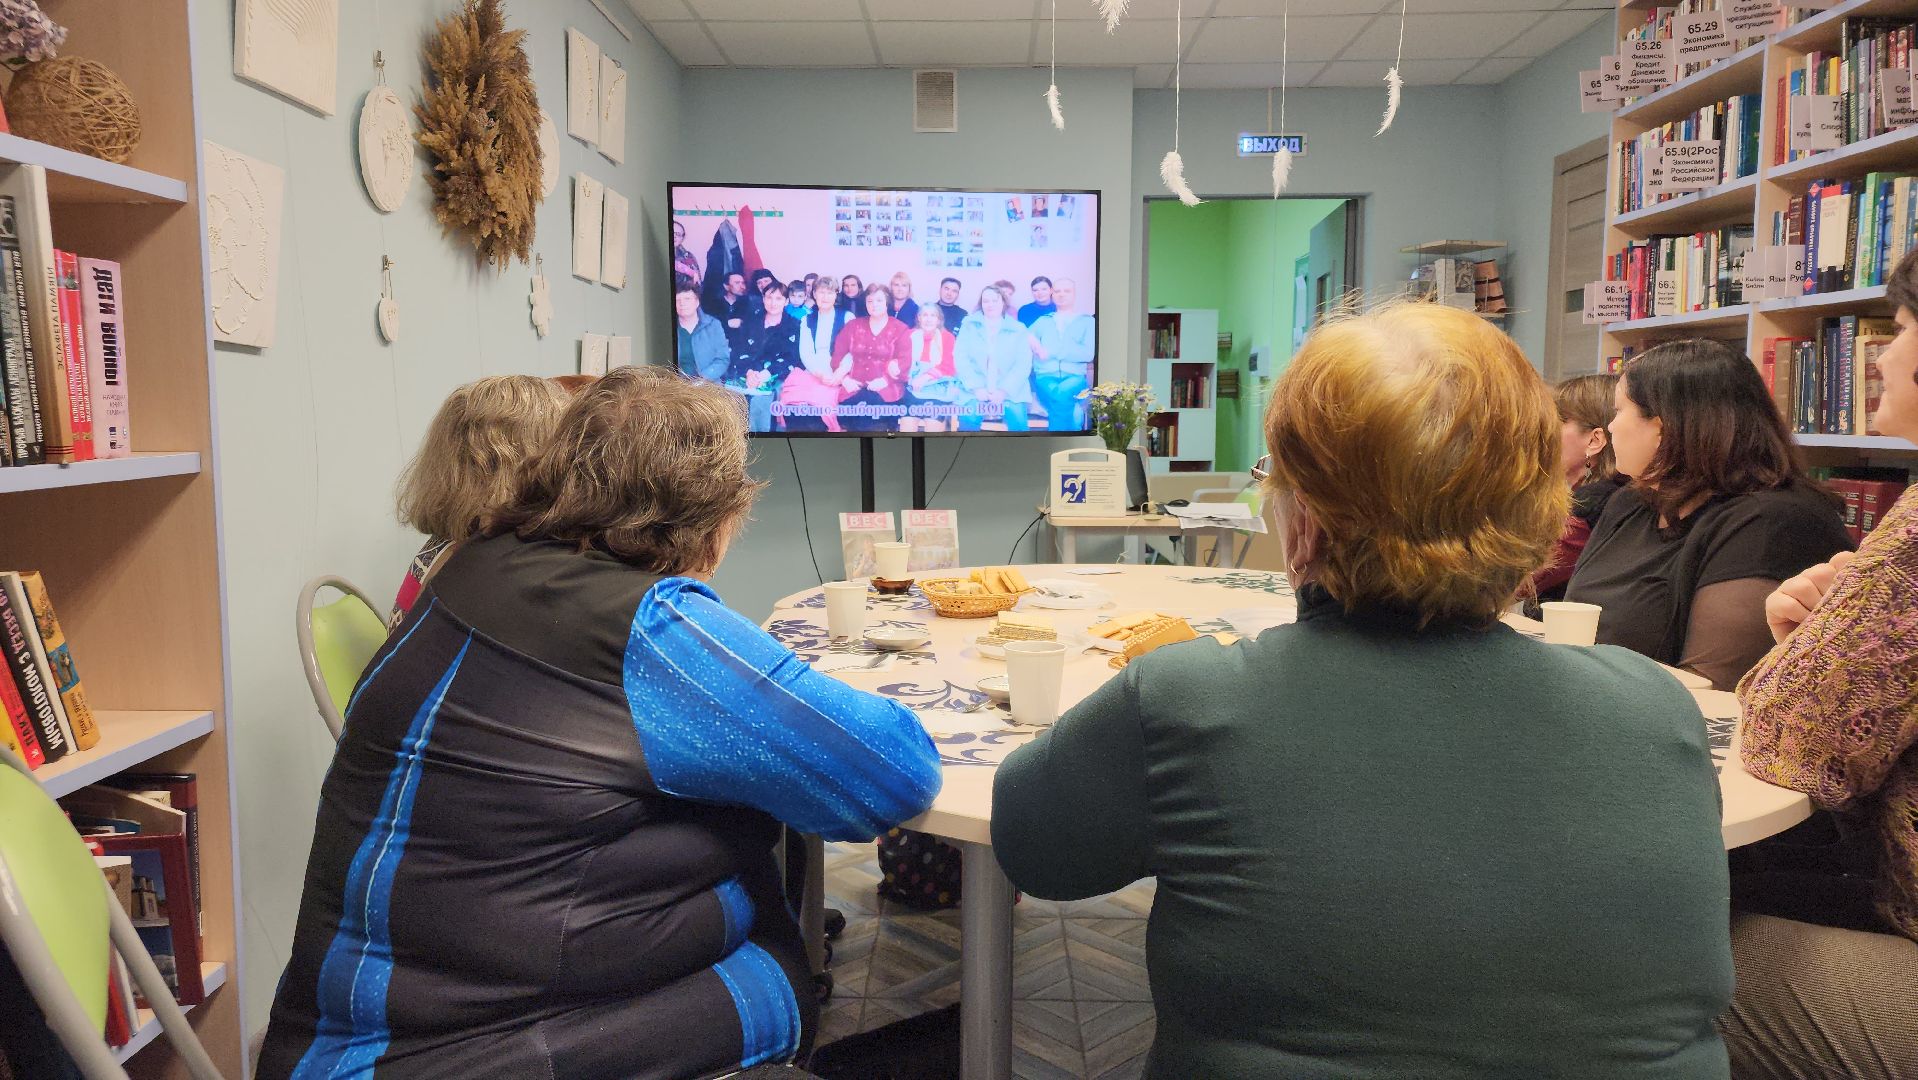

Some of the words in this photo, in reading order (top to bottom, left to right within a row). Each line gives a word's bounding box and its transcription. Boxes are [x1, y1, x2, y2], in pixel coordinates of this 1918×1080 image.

[1688, 20, 1718, 34] 65.29
[1636, 41, 1662, 50] 65.26
[1683, 32, 1725, 44] Экономика
[1680, 40, 1730, 54] предприятия
[1242, 137, 1300, 152] ВЫХОД
[1665, 146, 1720, 157] 65.9(2Рос
[47, 267, 58, 312] ПАМЯТИ
[92, 266, 118, 315] ДЕТИ
[53, 315, 65, 370] ЭСТАФЕТА
[100, 321, 122, 387] ВОЙНЫ
[11, 387, 25, 426] БЛОКАДЫ
[908, 402, 973, 418] собрание
[2, 606, 26, 655] БЕСЕД
[18, 651, 28, 666] С
[24, 662, 62, 750] МОЛОТОВЫМ
